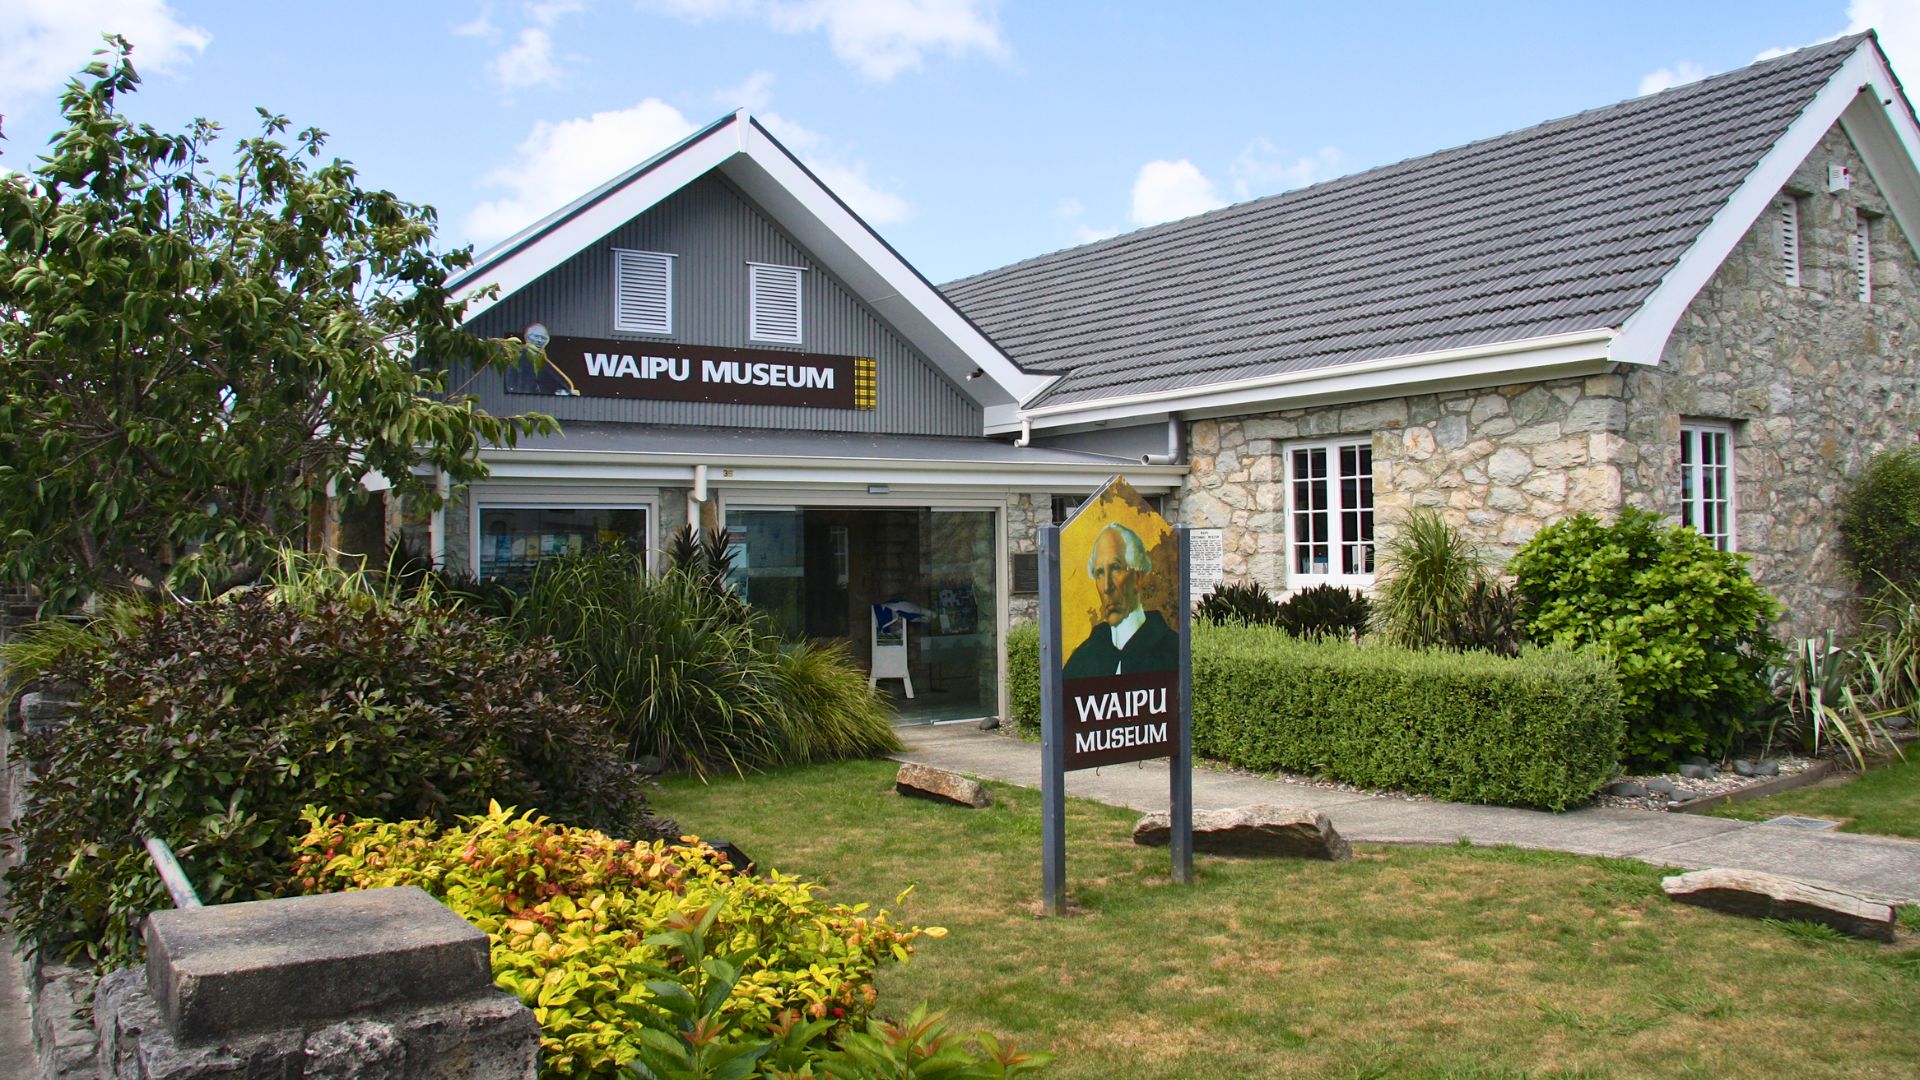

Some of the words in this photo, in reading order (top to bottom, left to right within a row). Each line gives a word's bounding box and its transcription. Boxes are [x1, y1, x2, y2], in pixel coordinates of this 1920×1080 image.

[583, 352, 690, 382] WAIPU
[701, 360, 835, 390] MUSEUM
[1074, 687, 1168, 723] WAIPU
[1075, 722, 1168, 754] MUSEUM
